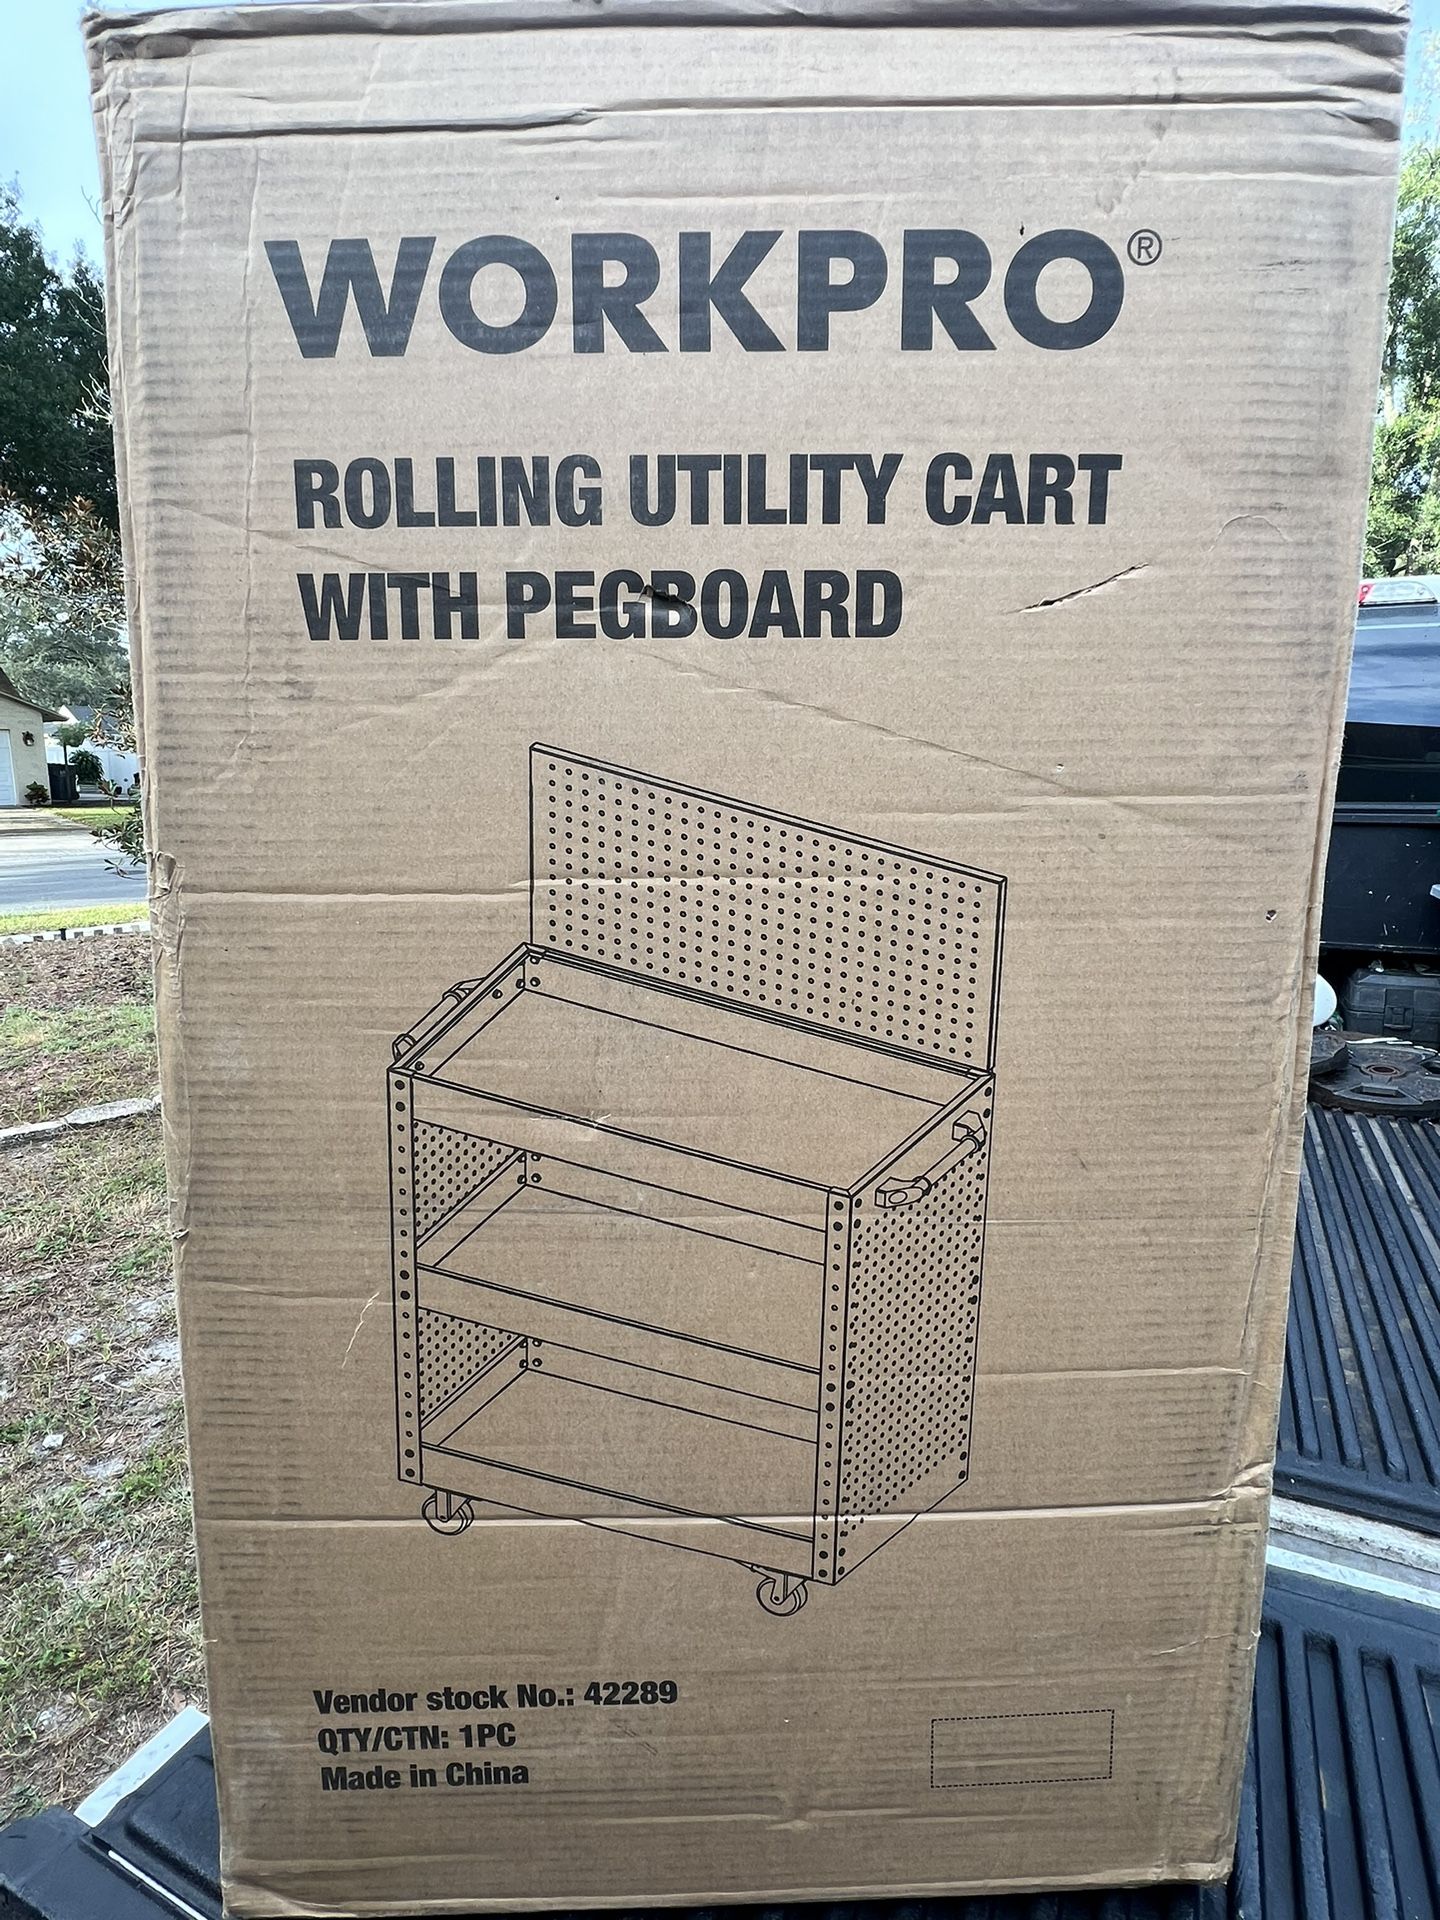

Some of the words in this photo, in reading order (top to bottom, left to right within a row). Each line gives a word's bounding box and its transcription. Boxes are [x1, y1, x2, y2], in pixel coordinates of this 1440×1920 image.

[293, 456, 602, 529] ROLLING
[629, 453, 902, 526] UTILITY
[926, 452, 1122, 525] CART
[296, 571, 478, 641] WITH
[507, 569, 903, 640] PEGBOARD
[313, 1688, 417, 1714] Vendor
[427, 1685, 509, 1711] stock
[517, 1684, 575, 1707] No.:
[584, 1680, 678, 1705] 42289
[318, 1724, 450, 1756] QTY/CTN:
[459, 1722, 516, 1749] 1PC
[321, 1765, 401, 1791] Made
[410, 1764, 437, 1788] in
[446, 1762, 529, 1787] China
